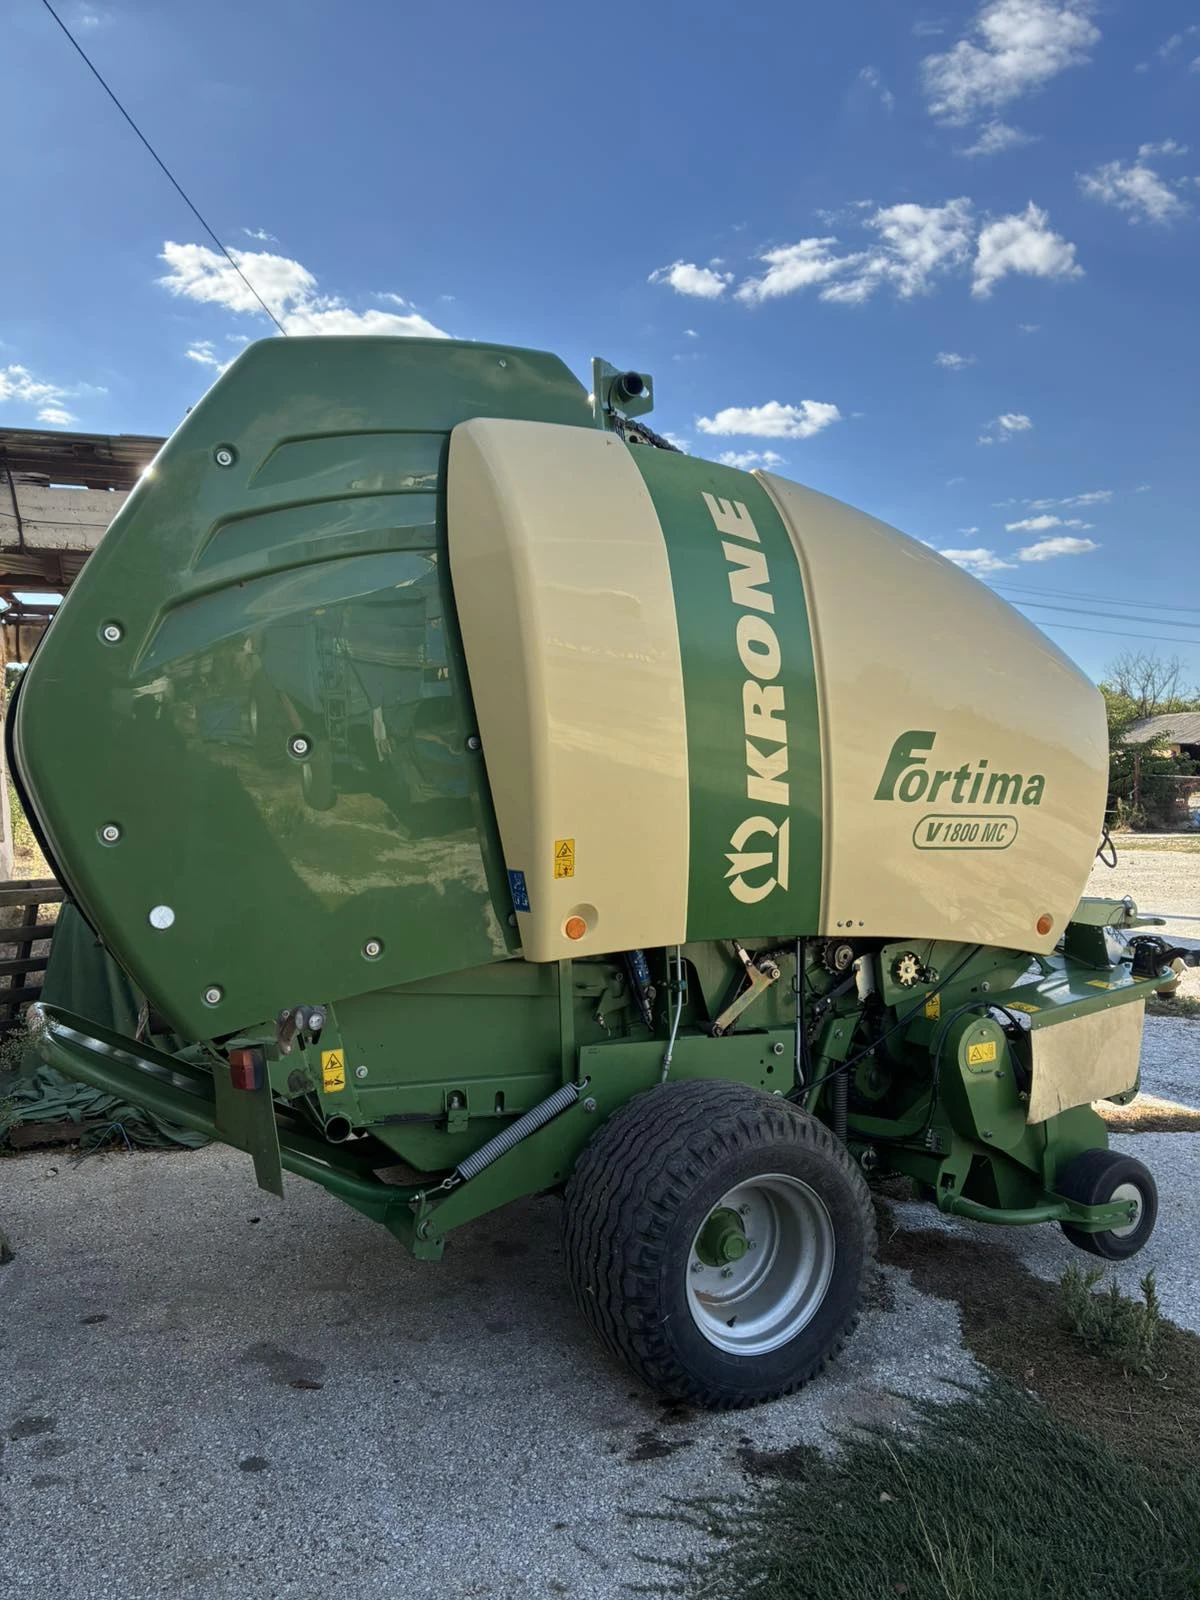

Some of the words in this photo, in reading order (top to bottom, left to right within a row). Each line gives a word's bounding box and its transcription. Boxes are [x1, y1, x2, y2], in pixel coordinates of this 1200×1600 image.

[702, 491, 789, 806] KRONE
[873, 730, 1046, 805] Fortima
[980, 823, 1008, 842] MC
